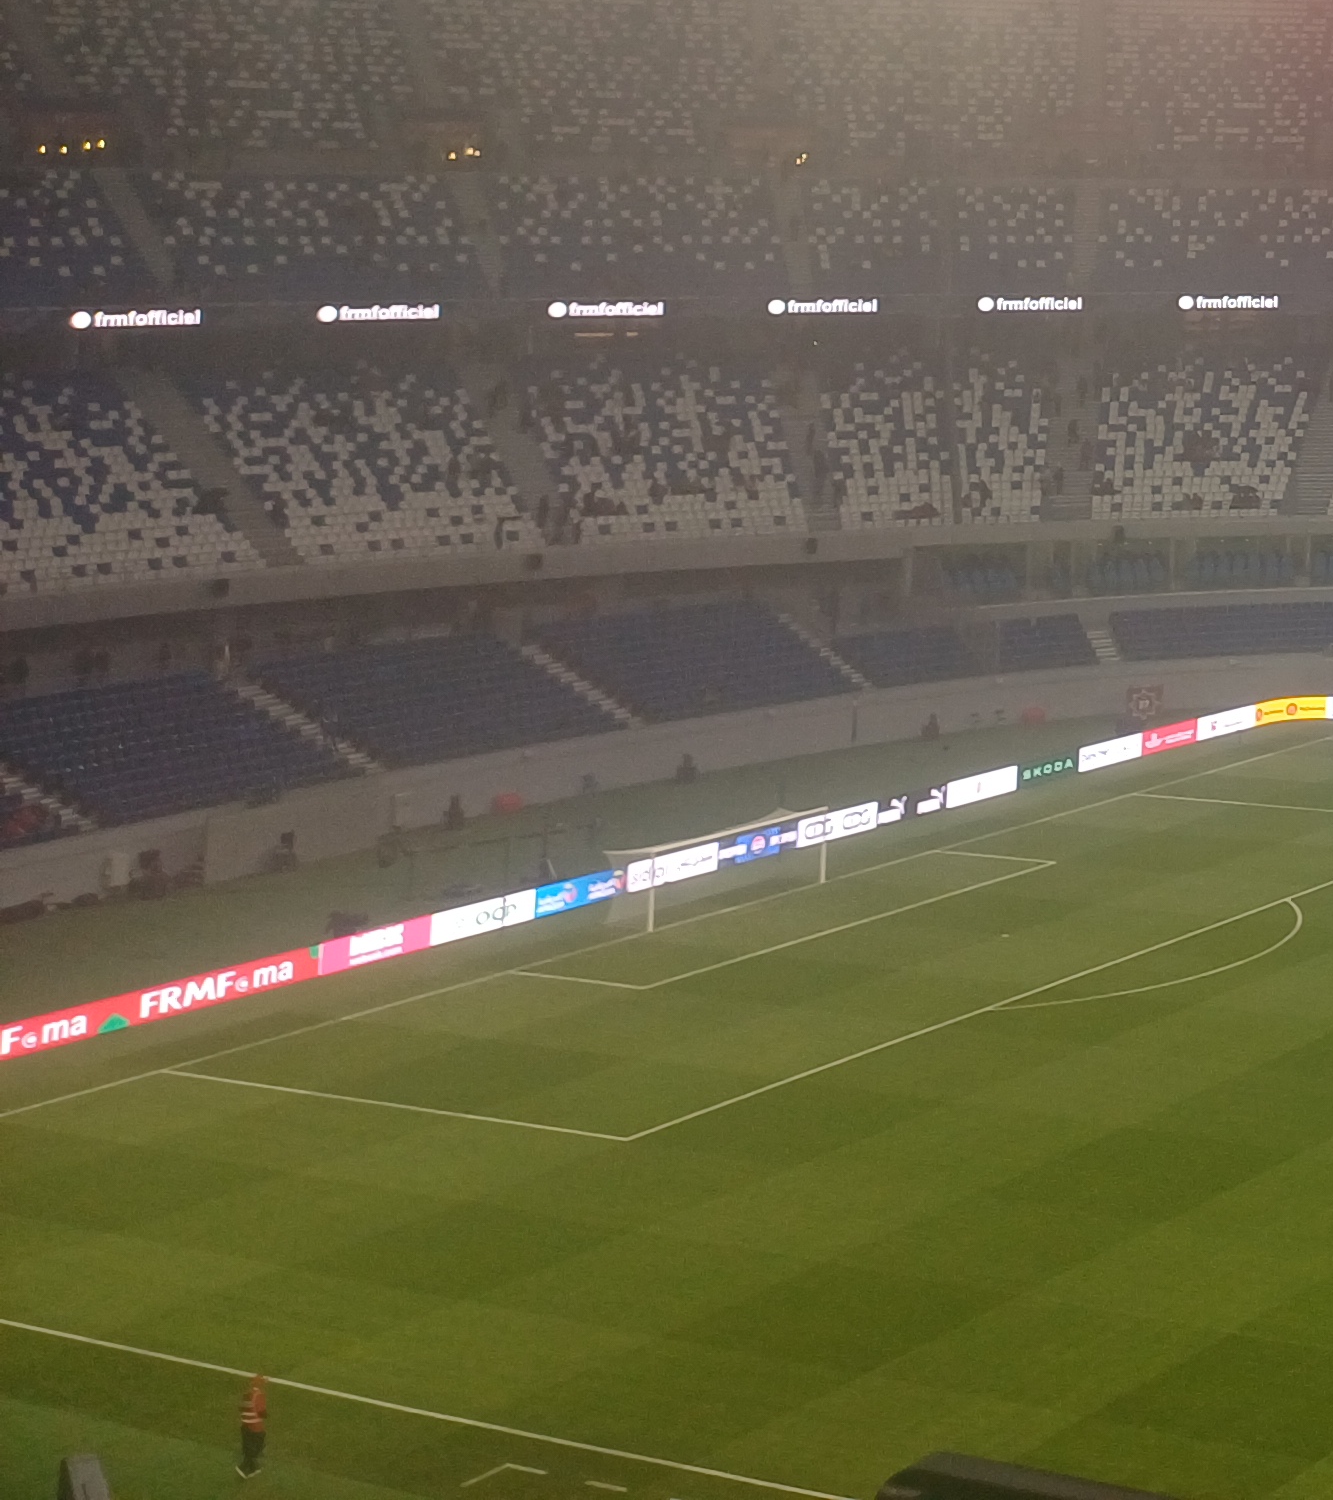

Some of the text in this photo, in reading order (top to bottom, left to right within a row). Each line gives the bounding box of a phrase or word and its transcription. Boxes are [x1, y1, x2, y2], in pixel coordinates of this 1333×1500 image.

[569, 301, 664, 317] frmfofficiel
[788, 298, 878, 314] frmfofficiel
[997, 296, 1083, 311] frmfofficiel
[1196, 295, 1279, 309] frmfofficiel
[94, 309, 201, 328] frmfofficiel
[339, 303, 440, 321] frmfofficiel
